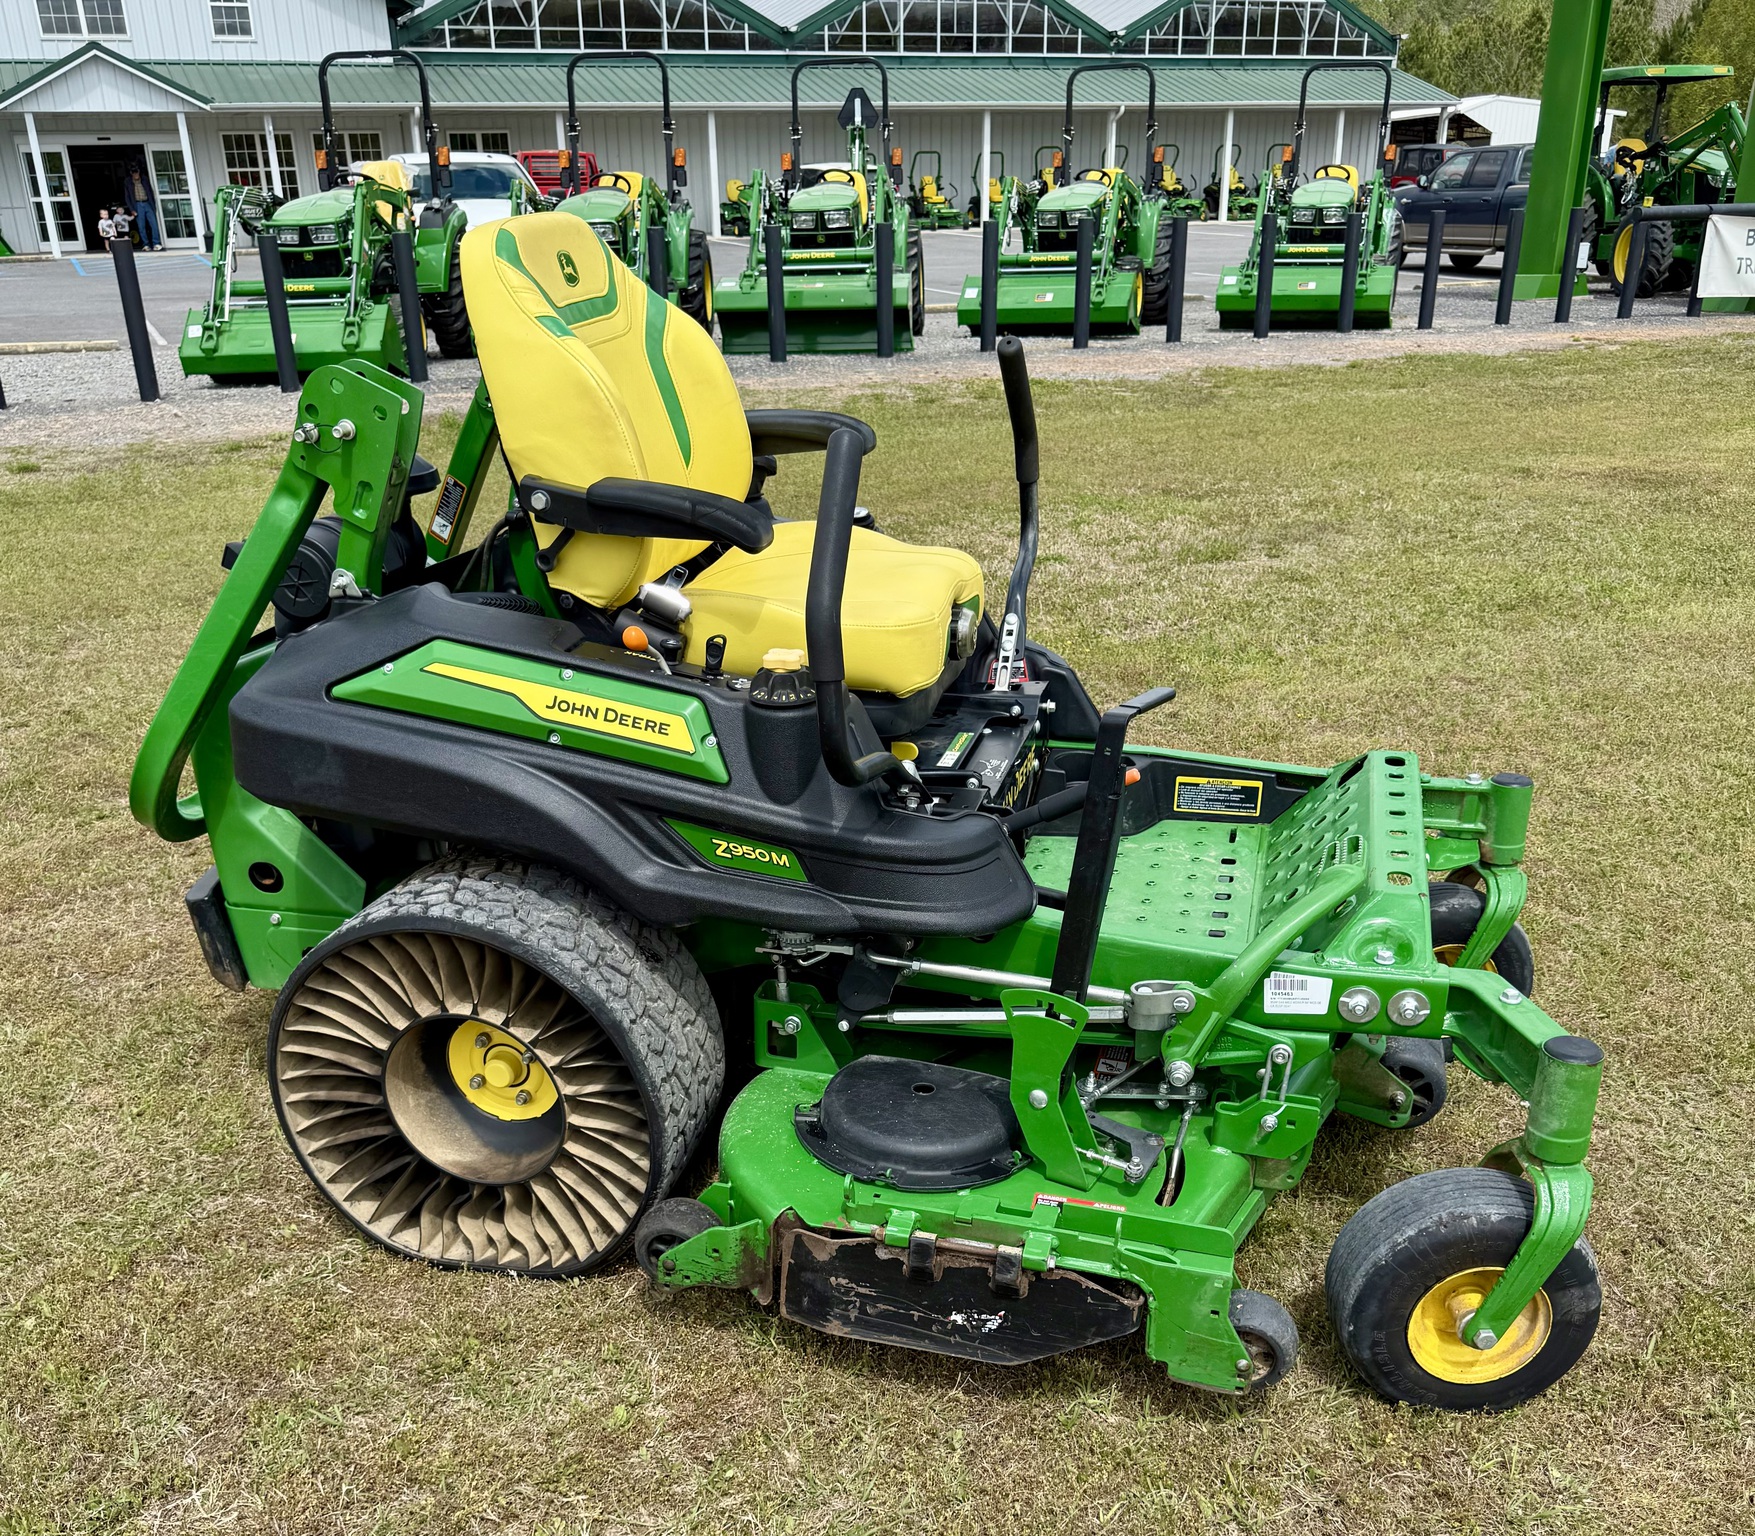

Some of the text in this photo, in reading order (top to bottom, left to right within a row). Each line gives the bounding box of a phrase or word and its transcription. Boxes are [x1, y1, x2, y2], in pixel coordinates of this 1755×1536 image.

[790, 251, 836, 260] JOHN DEERE
[1029, 254, 1070, 262] JOHN DEERE
[1736, 257, 1755, 275] TR
[287, 284, 315, 292] DEERE
[545, 695, 671, 736] JOHN DEERE
[1043, 1194, 1067, 1203] DANGER
[1099, 1203, 1126, 1212] PELIGRO
